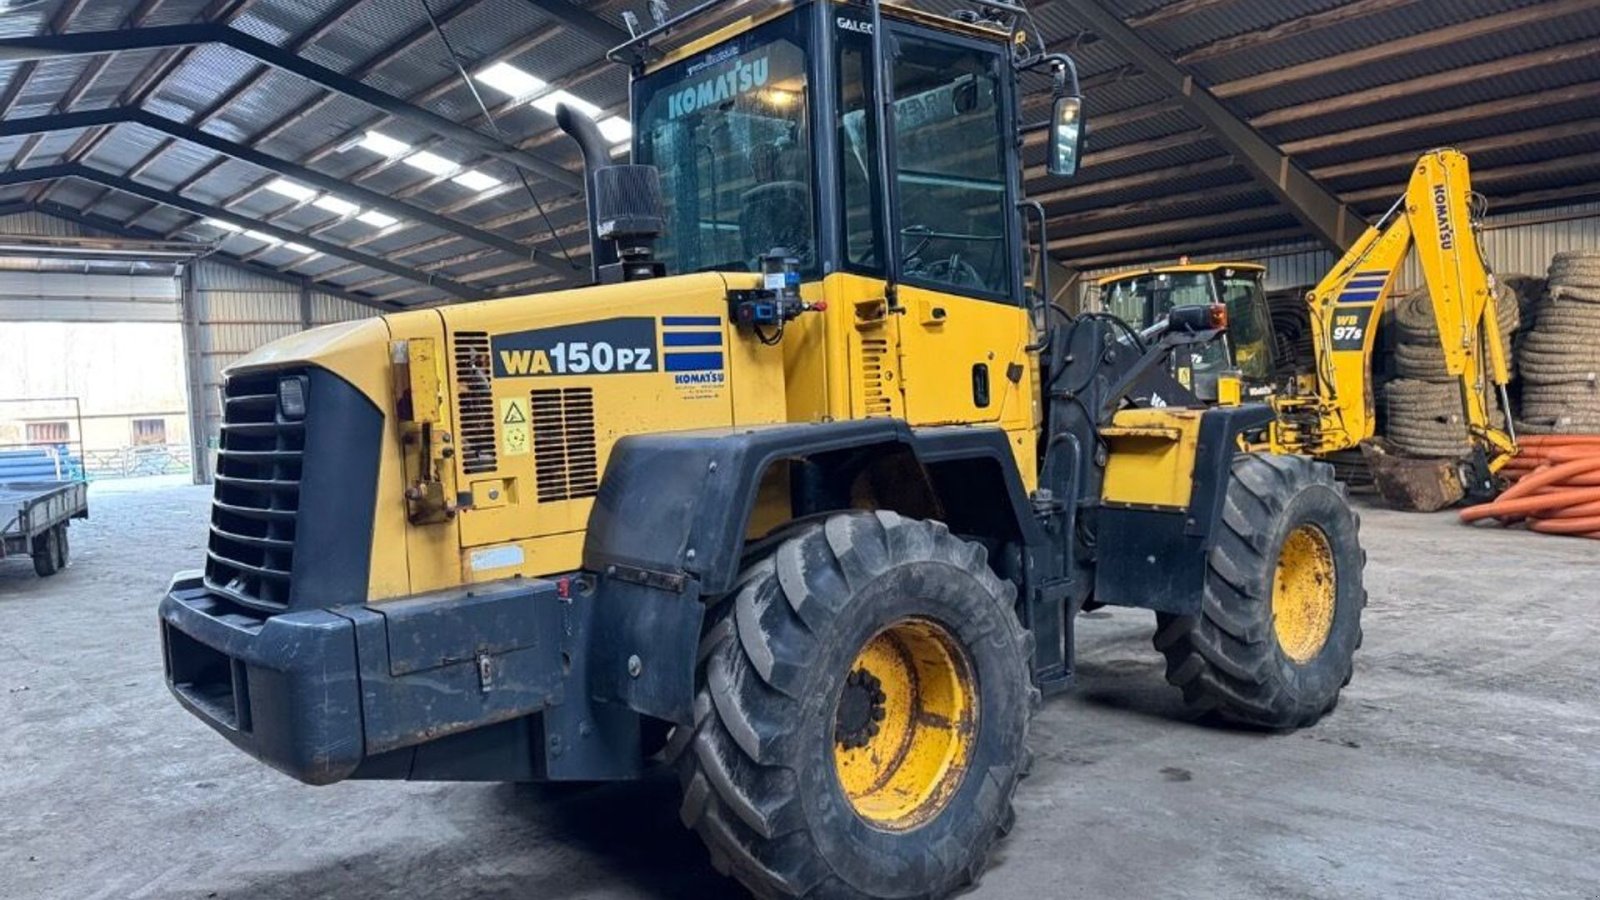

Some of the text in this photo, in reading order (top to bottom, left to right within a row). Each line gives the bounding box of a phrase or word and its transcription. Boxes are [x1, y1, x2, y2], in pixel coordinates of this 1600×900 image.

[668, 57, 769, 119] KOMATSU
[1433, 184, 1453, 249] KOMATSU
[1336, 315, 1358, 326] WB
[675, 371, 724, 384] KOMATSU
